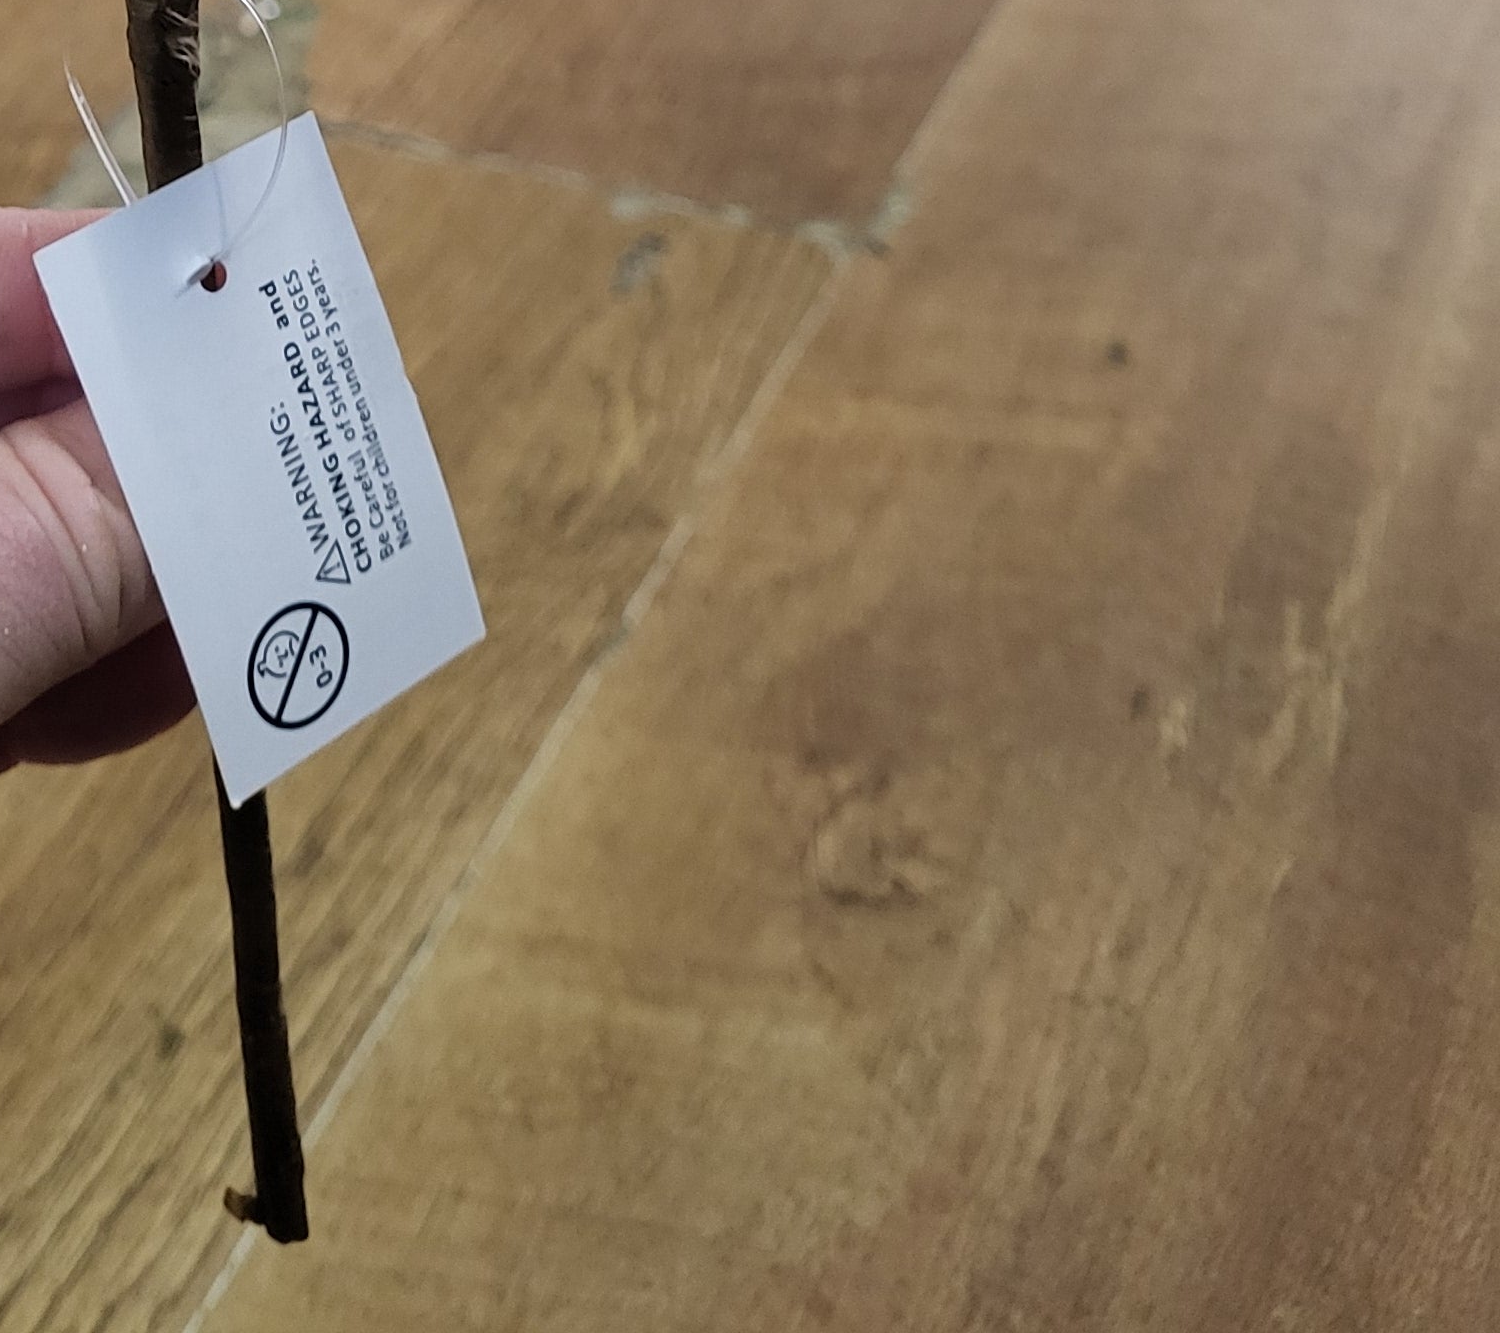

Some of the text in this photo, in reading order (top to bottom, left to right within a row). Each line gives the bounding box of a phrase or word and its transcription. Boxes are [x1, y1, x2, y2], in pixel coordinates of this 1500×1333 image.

[259, 280, 372, 573] CHOKING HAZARD and
[270, 401, 329, 554] WARNING:
[283, 269, 394, 561] Be Careful of SHARP EDGES
[307, 259, 411, 549] Not for children under 3 years.
[309, 644, 333, 688] 0-3
